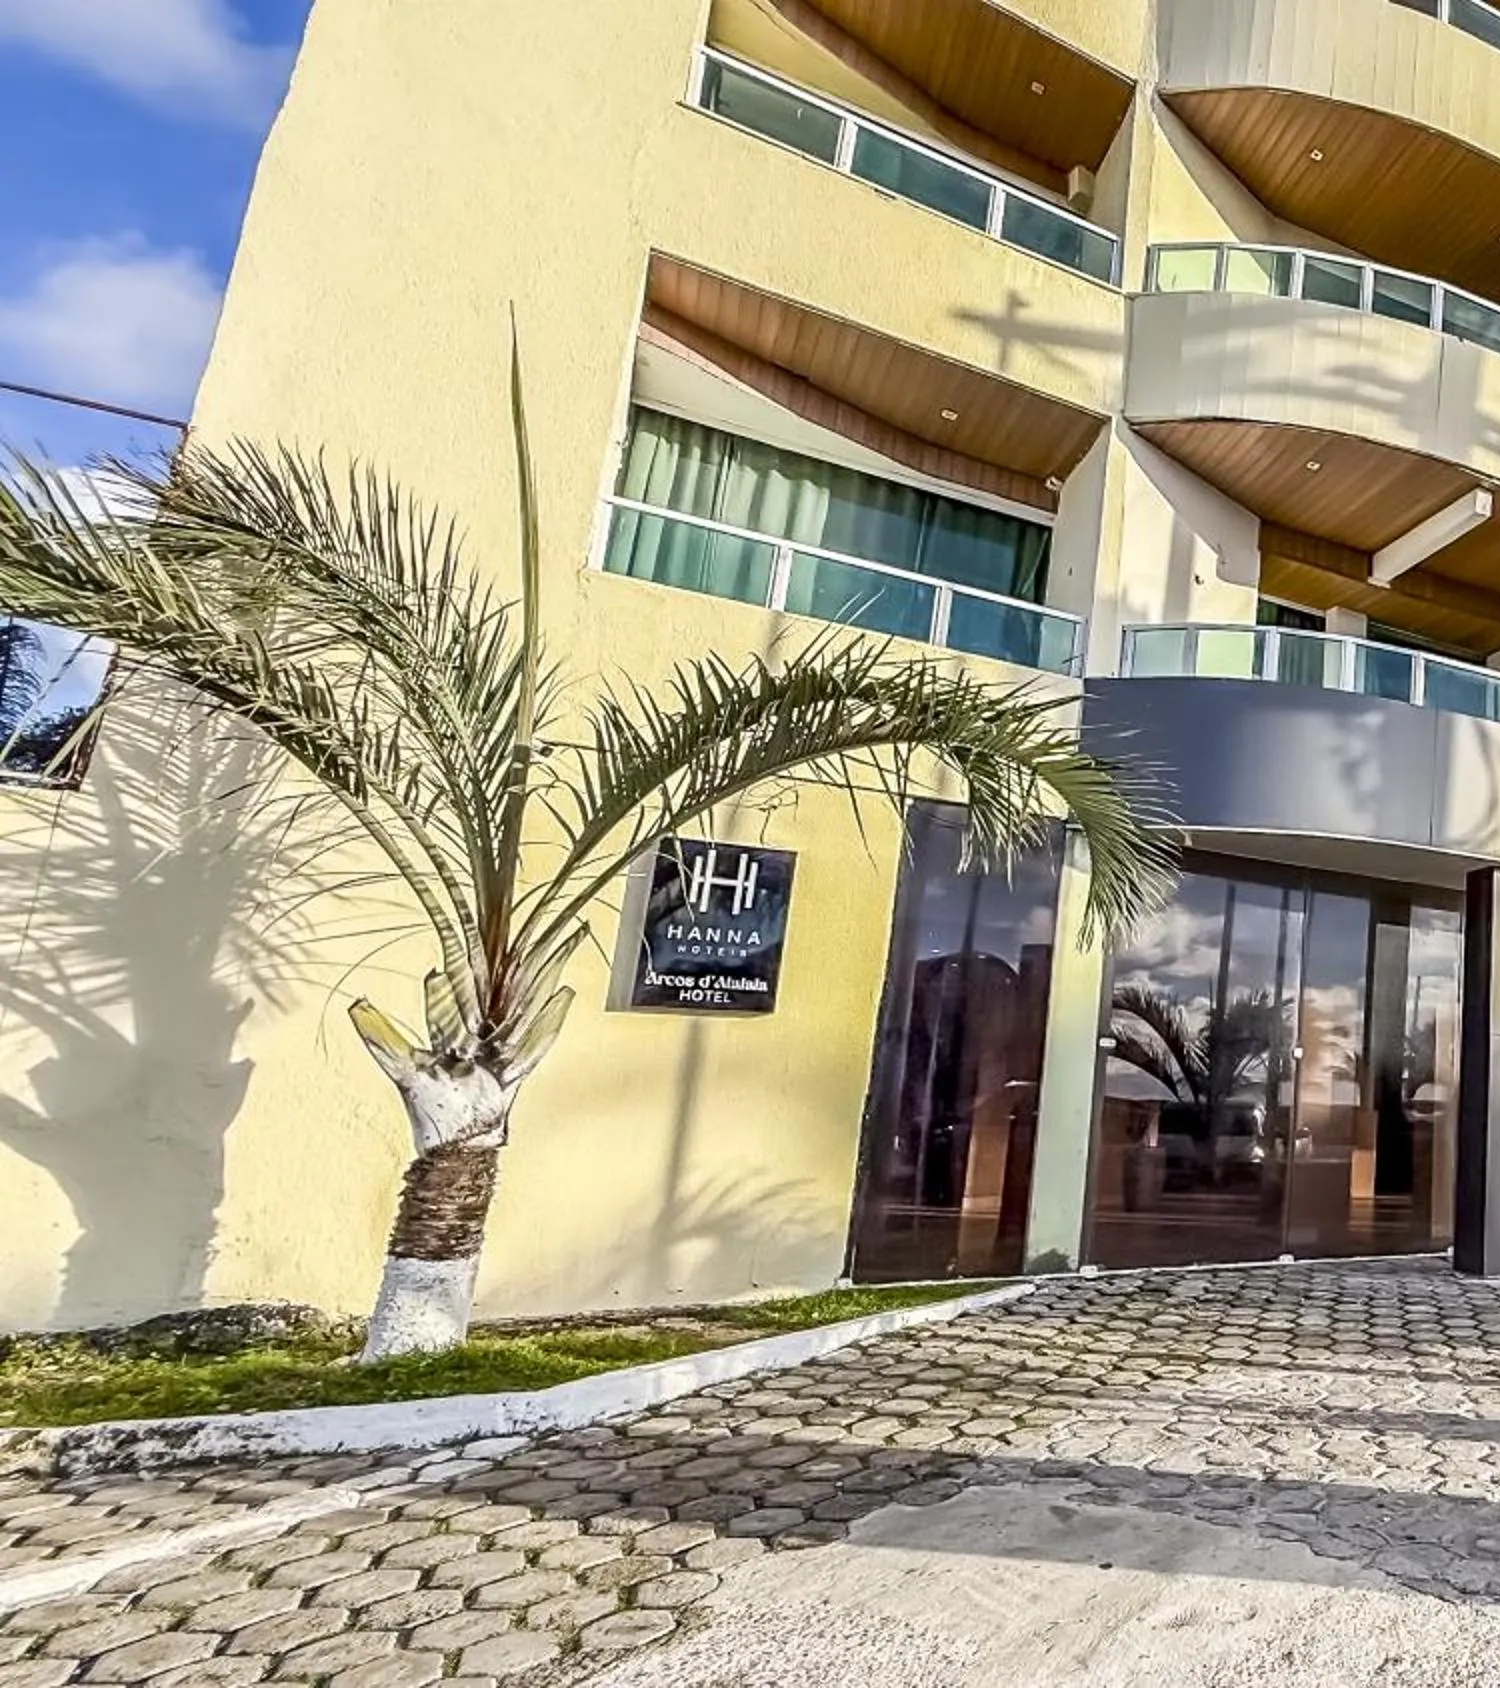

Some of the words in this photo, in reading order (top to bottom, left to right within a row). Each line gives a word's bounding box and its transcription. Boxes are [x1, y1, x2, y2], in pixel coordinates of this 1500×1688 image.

[667, 924, 761, 945] HANNA
[644, 971, 695, 989] Arcos
[679, 988, 732, 1003] HOTEL
